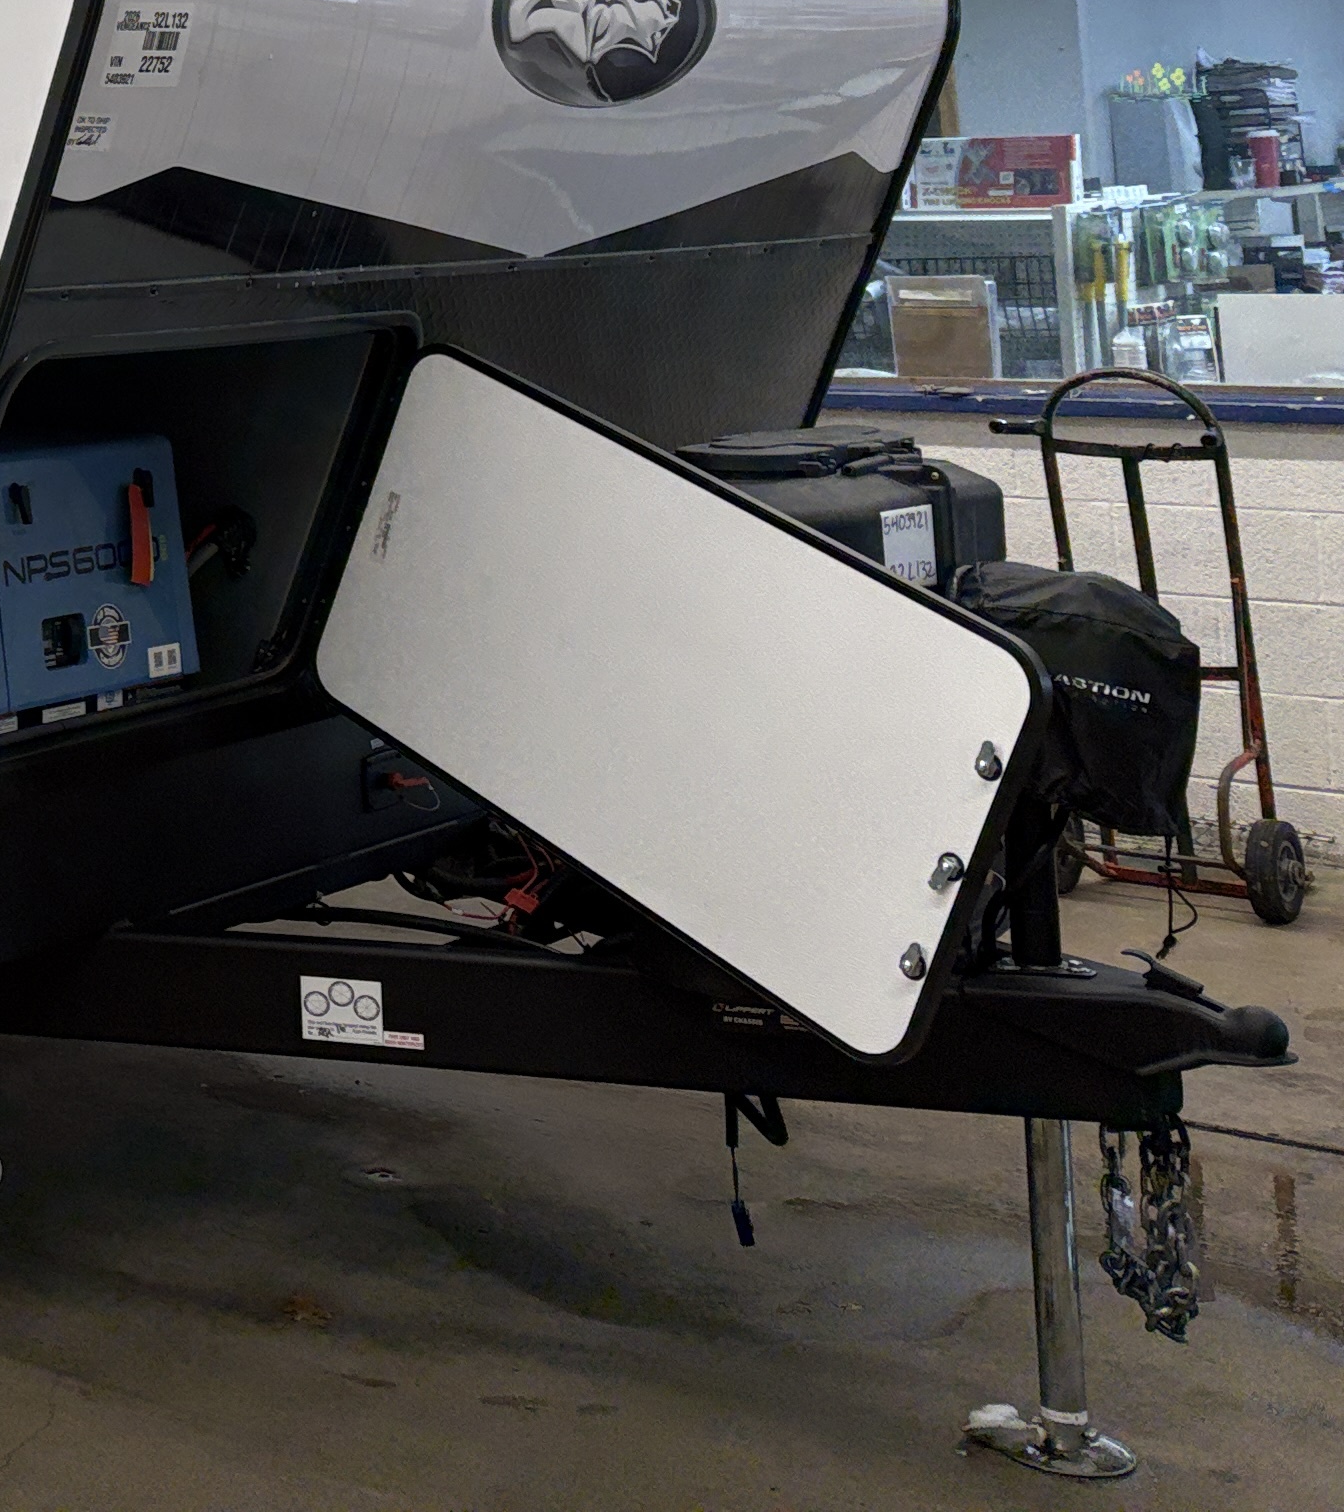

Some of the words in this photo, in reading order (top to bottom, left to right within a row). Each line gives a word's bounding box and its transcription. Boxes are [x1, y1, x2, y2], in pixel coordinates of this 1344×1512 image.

[152, 11, 189, 29] 32L132
[138, 55, 173, 73] 22752
[883, 510, 929, 536] 5403921
[1053, 674, 1152, 704] ASTION
